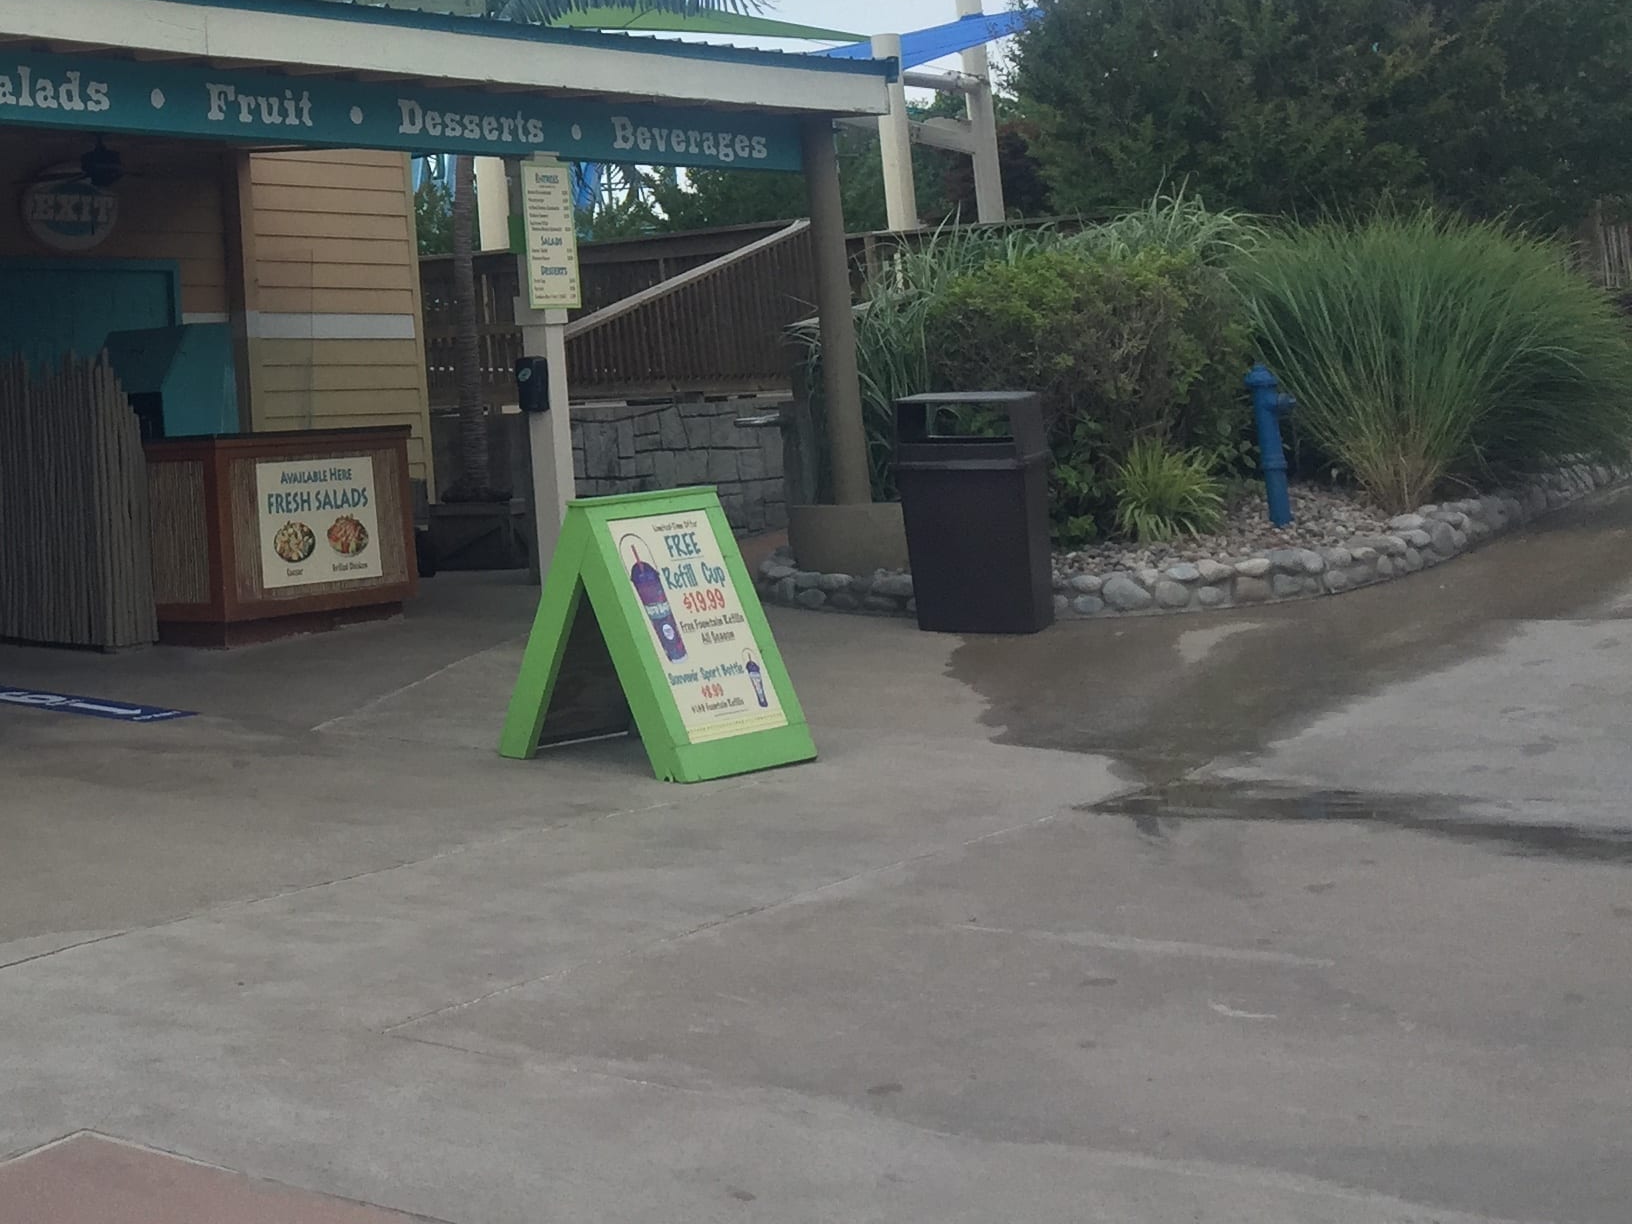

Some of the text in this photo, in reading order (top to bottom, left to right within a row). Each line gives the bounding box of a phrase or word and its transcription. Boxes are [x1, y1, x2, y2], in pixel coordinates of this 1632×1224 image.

[207, 82, 315, 128] Fruit
[397, 98, 545, 145] Desserts
[612, 116, 768, 162] Beverages
[31, 192, 115, 223] EXIT
[280, 467, 353, 485] AVAILABLE HERE
[268, 487, 369, 515] FRESH SALADS
[664, 531, 701, 558] FREE
[661, 561, 727, 591] Refill Cup
[683, 587, 726, 614] $19.99
[700, 666, 722, 682] Sport
